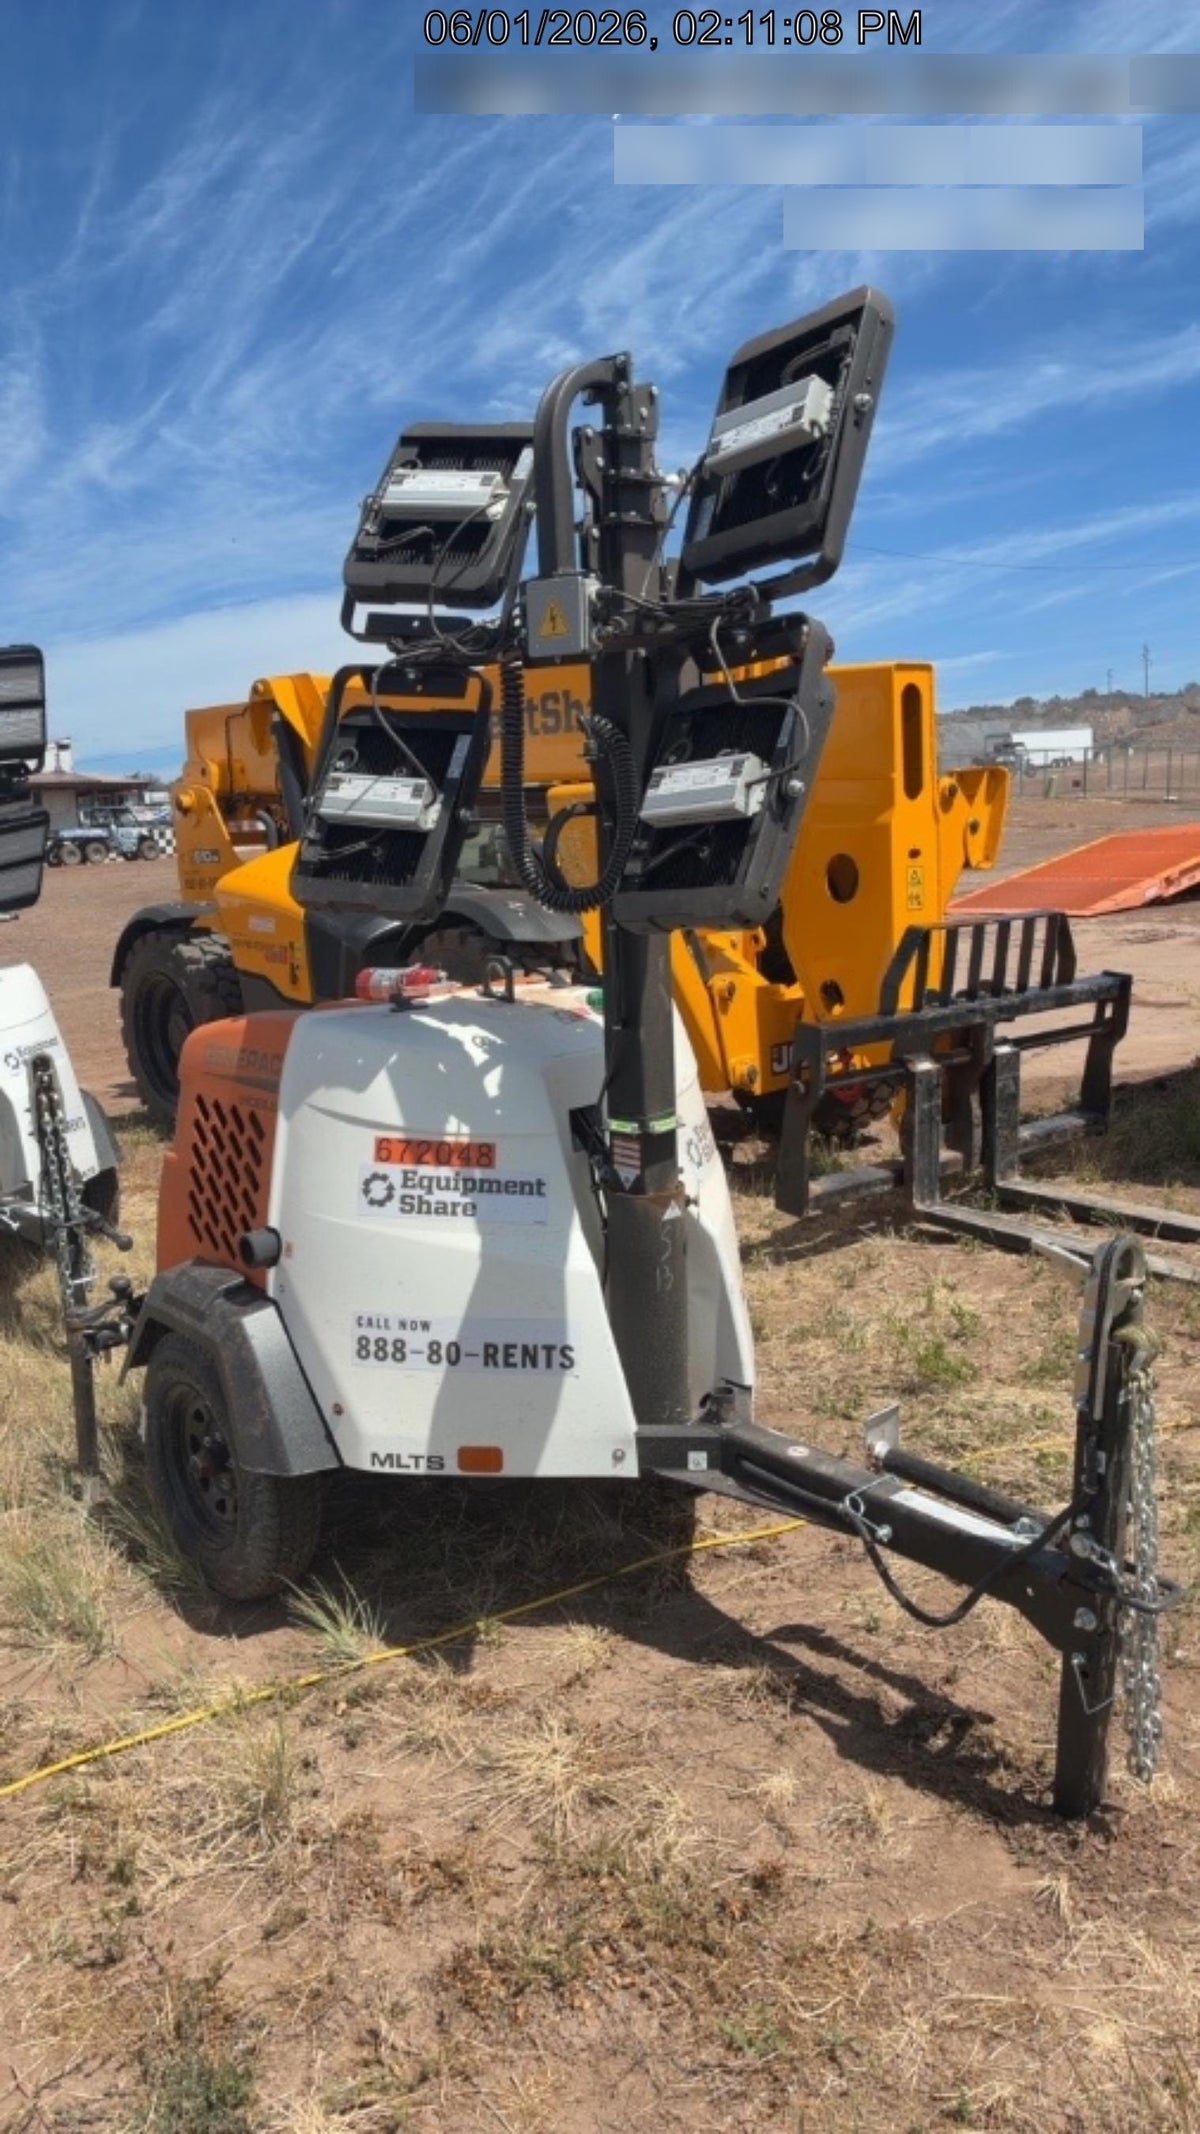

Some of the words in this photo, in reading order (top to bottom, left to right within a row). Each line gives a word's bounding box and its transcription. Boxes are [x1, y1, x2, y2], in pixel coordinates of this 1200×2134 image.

[376, 1137, 494, 1168] 672048
[400, 1169, 547, 1197] Equipment
[399, 1194, 478, 1217] Share
[356, 1316, 391, 1331] CALL
[398, 1320, 432, 1332] NOW
[356, 1335, 576, 1370] 888-80-RENTS
[370, 1452, 446, 1471] MLTS
